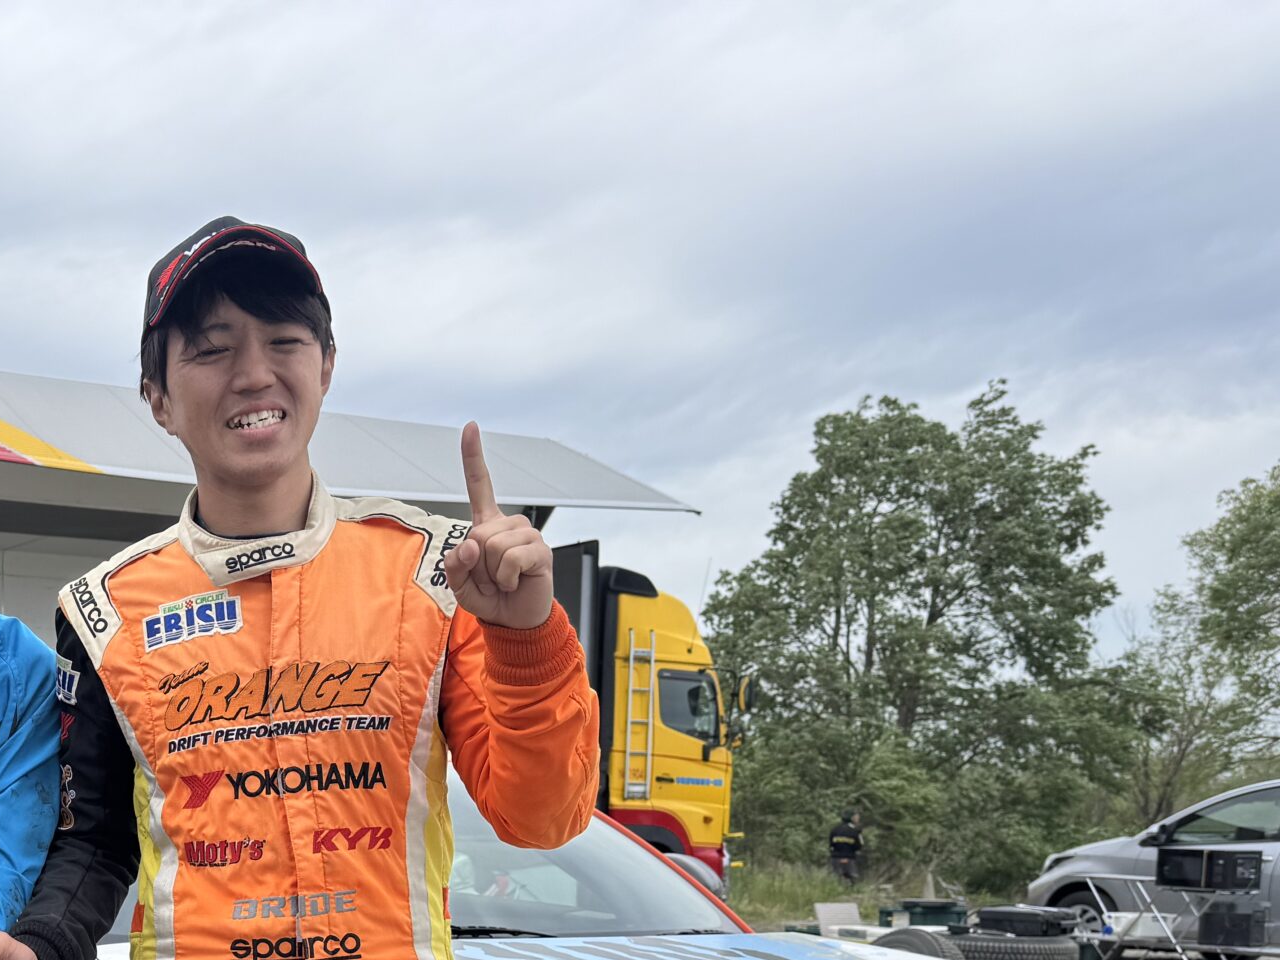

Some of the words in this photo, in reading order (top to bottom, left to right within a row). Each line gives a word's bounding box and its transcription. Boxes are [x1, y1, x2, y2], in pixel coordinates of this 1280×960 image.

[225, 541, 295, 574] sparco
[70, 577, 108, 637] sparco
[194, 592, 226, 604] CIRCUIT
[145, 599, 238, 648] EBISU
[164, 660, 391, 731] ORANGE
[167, 732, 212, 754] DRIFT
[213, 716, 341, 745] PERFORMANCE
[345, 716, 391, 731] TEAM
[225, 762, 387, 800] YOKOHAMA
[183, 835, 264, 865] Moty's
[312, 826, 393, 854] KYB
[231, 889, 357, 921] BRIDE
